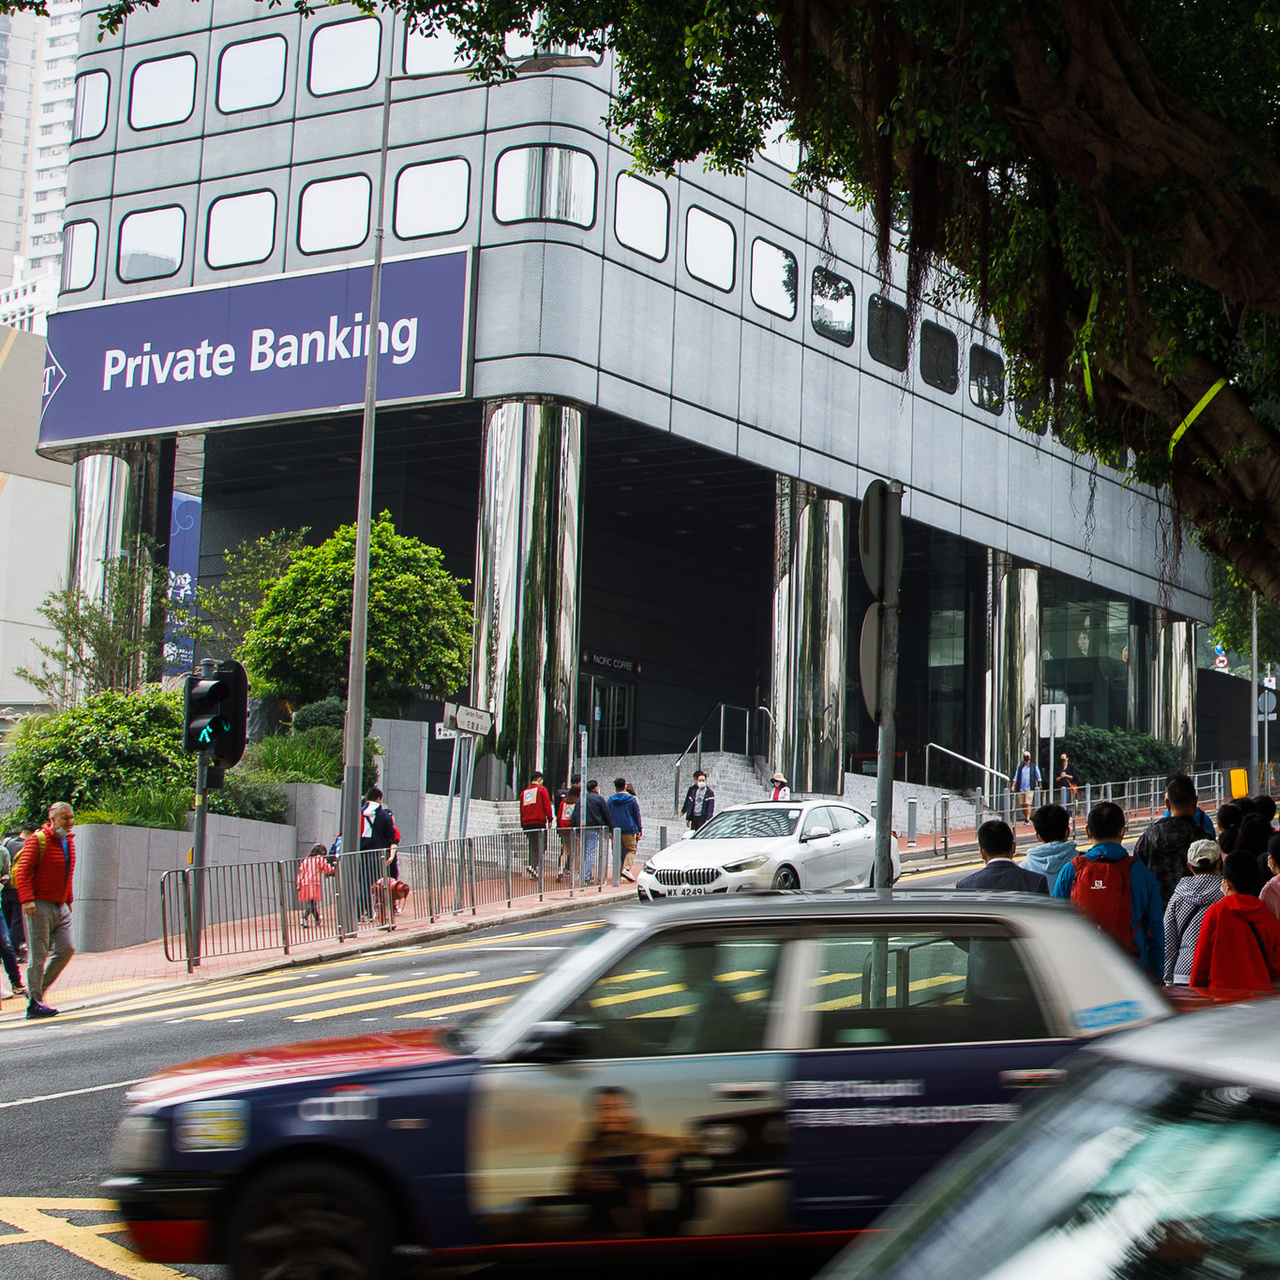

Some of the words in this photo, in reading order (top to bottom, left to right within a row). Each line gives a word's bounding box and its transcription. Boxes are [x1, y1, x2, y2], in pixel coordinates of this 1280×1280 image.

[102, 339, 236, 391] Private
[249, 312, 419, 373] Banking
[592, 654, 612, 667] PACIFIC
[612, 659, 633, 671] COFFEE
[681, 887, 703, 896] 4249
